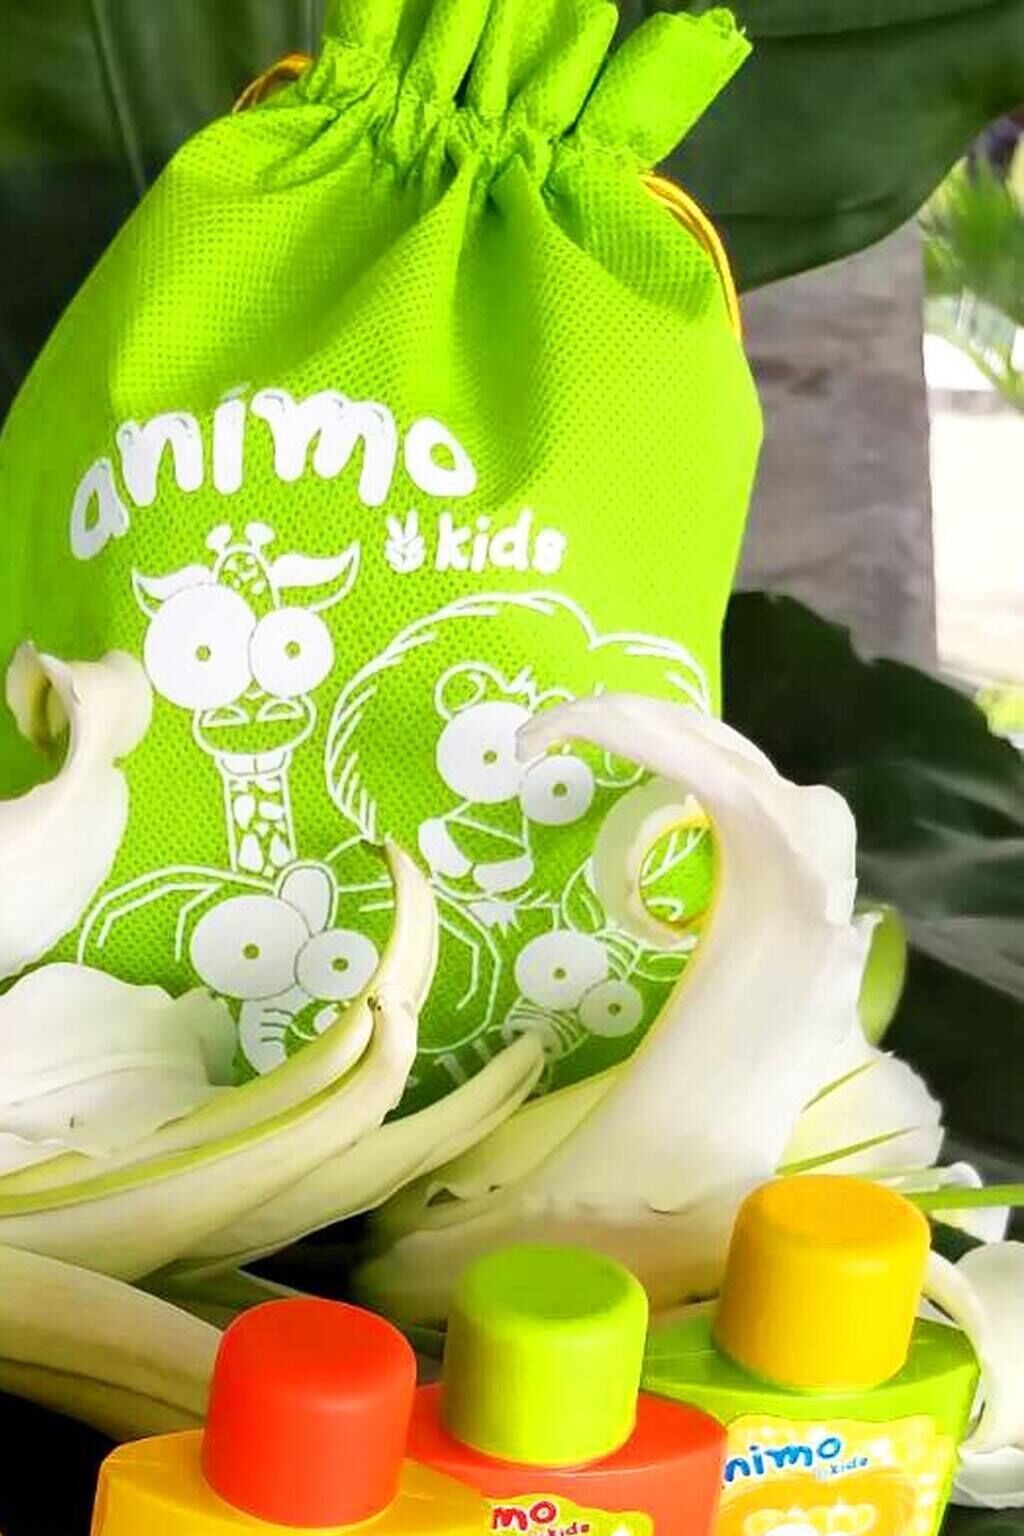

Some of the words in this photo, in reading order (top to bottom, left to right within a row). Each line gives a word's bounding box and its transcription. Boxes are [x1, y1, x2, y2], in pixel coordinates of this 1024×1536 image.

[69, 383, 478, 560] animo
[435, 506, 567, 574] kids
[724, 1437, 841, 1482] nimo
